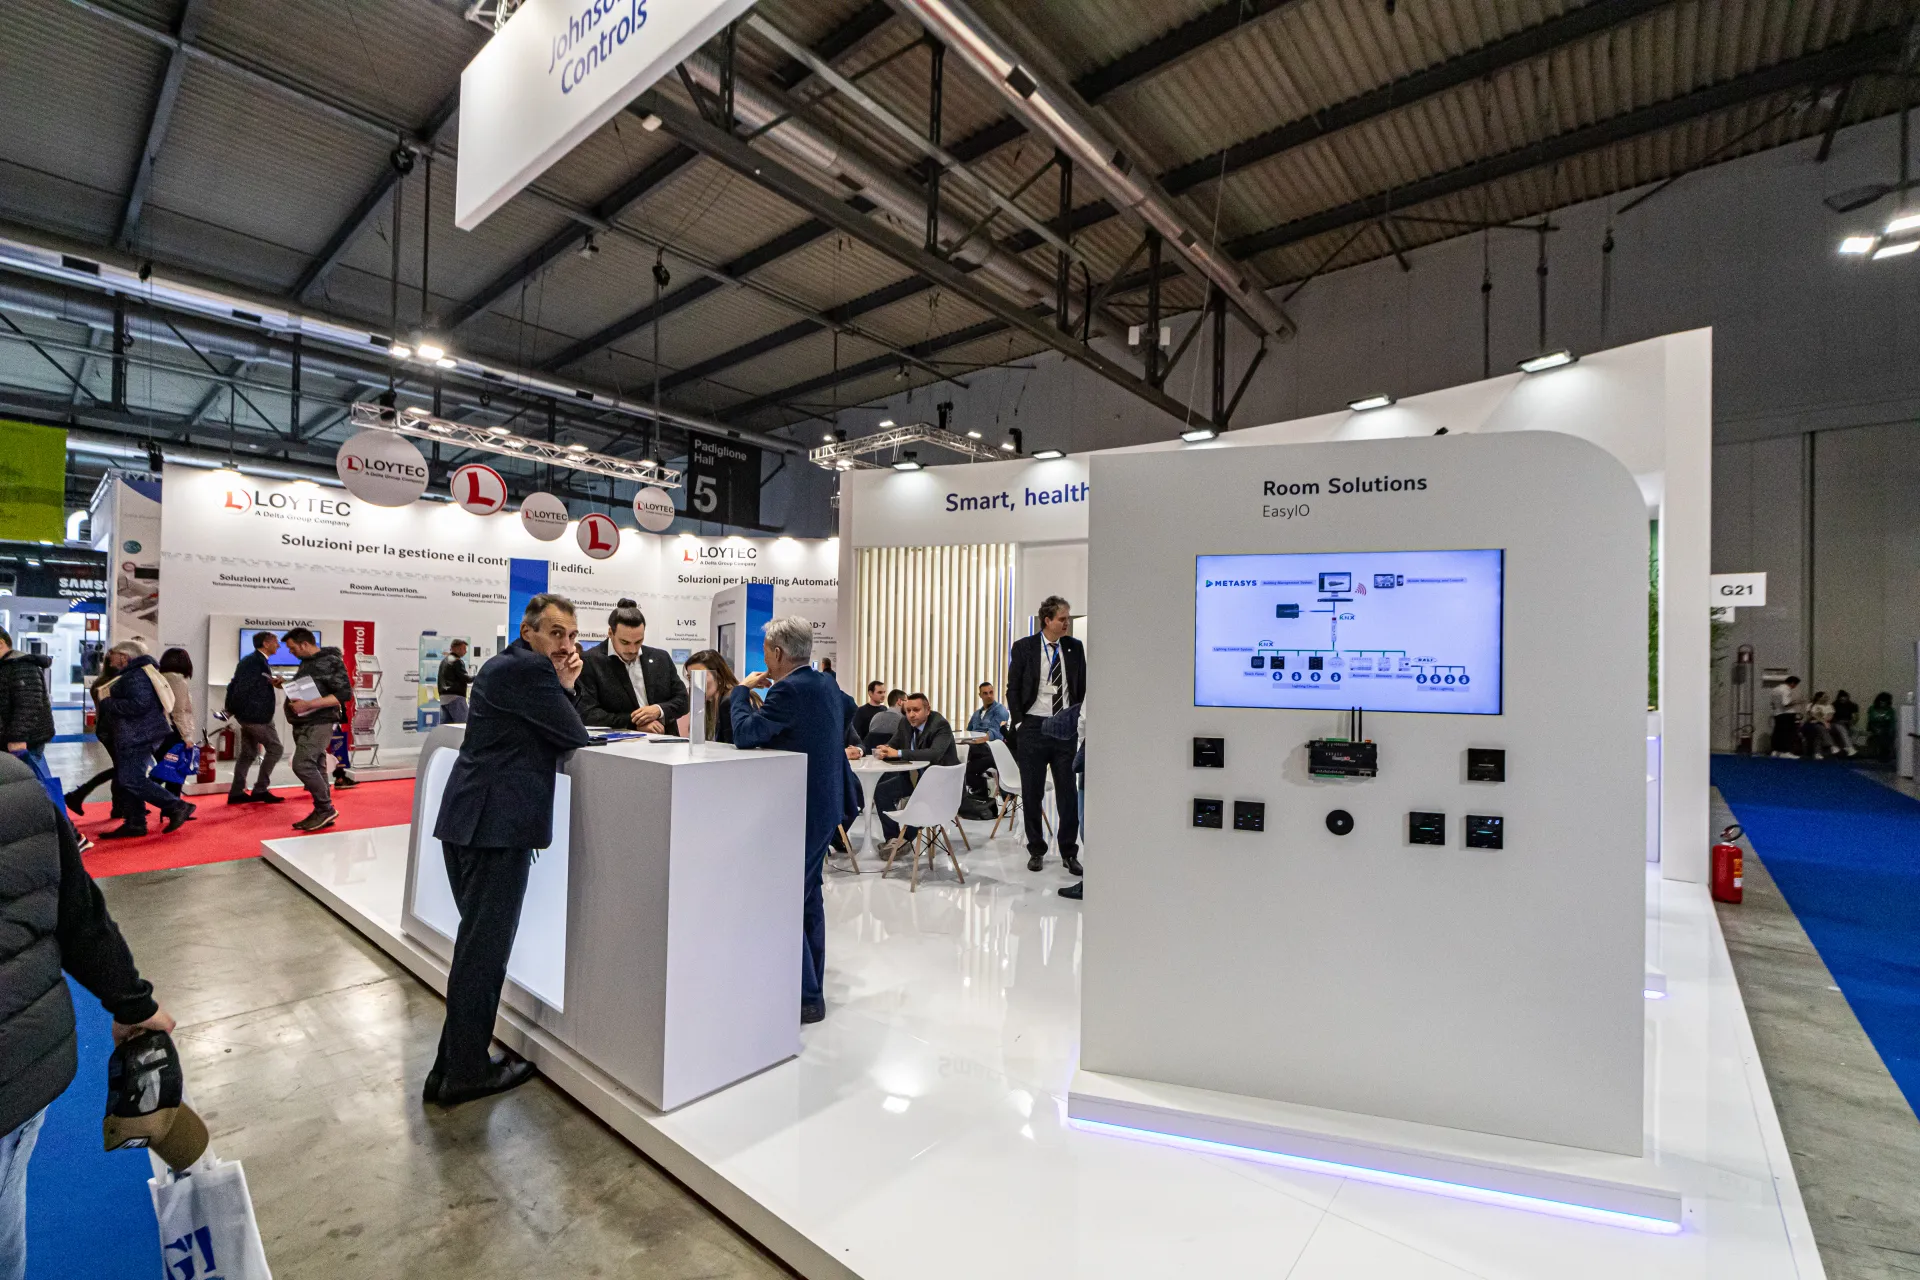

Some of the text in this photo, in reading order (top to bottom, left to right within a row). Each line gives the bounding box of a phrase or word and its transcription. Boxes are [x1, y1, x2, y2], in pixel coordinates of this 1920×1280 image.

[549, 0, 621, 75] Johnso
[561, 0, 647, 94] Controls
[694, 439, 747, 461] Padiglione
[694, 452, 714, 466] Hall
[365, 458, 425, 478] LOYTEC
[1263, 475, 1428, 496] Room Solutions
[693, 474, 718, 513] 5
[255, 490, 351, 517] LOYTEC
[645, 502, 674, 514] LOYTEC
[945, 492, 1016, 511] Smart,
[263, 511, 285, 519] Delta
[535, 510, 568, 521] LOYTEC
[1262, 504, 1310, 519] EasyIO
[281, 533, 352, 552] Soluzioni
[356, 542, 380, 555] per
[383, 544, 396, 556] la
[398, 548, 455, 561] gestione
[457, 554, 465, 562] e
[467, 552, 475, 563] il
[560, 563, 595, 575] edifici.
[700, 546, 757, 559] LOYTEC
[219, 573, 261, 583] Soluzioni
[677, 574, 721, 585] Soluzioni
[723, 576, 739, 586] per
[740, 575, 749, 585] la
[751, 575, 790, 587] Building
[1214, 579, 1257, 587] METASYS
[349, 583, 373, 591] Room
[1720, 584, 1754, 596] G21
[451, 590, 481, 598] Soluzioni
[245, 618, 286, 627] Soluzioni
[677, 619, 697, 627] L-VIS
